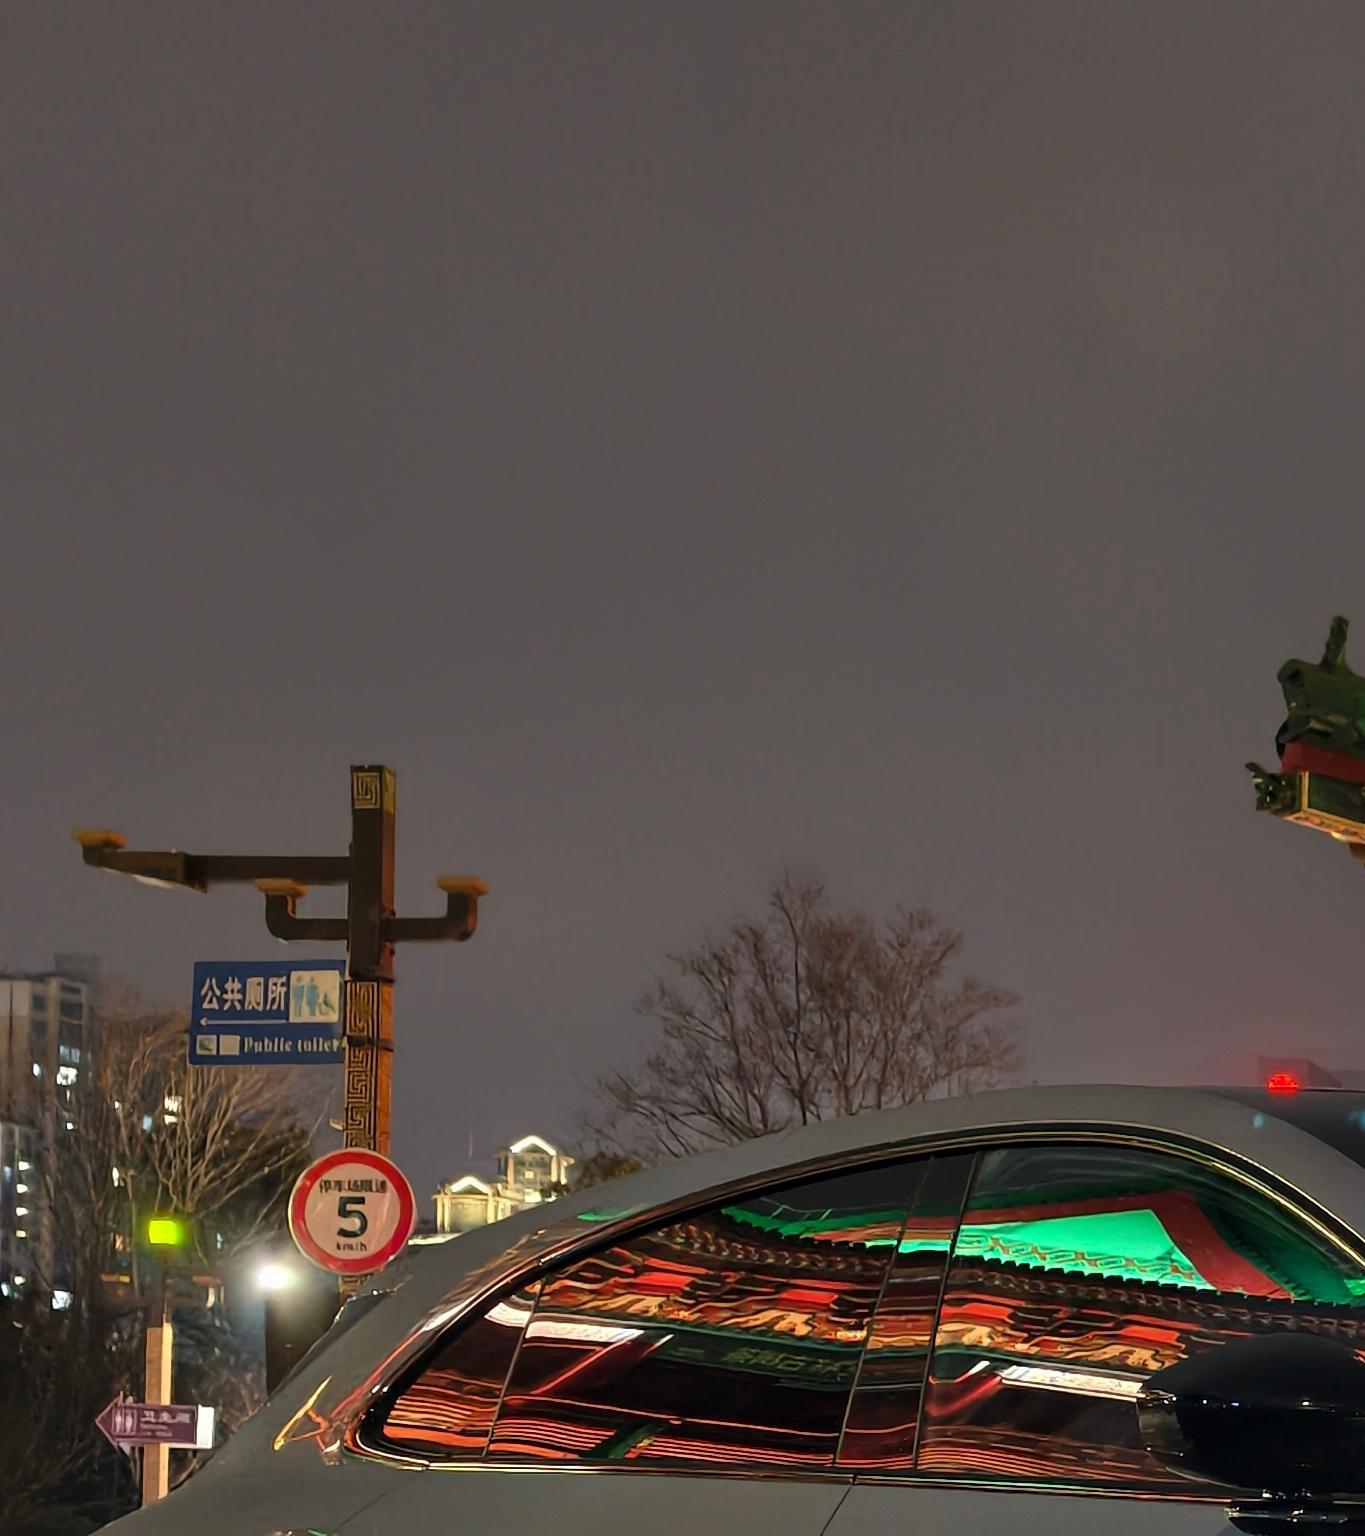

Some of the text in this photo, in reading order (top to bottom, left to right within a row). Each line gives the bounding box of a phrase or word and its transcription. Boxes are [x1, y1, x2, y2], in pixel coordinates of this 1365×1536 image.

[200, 976, 287, 1011] 公共厕所
[244, 1036, 292, 1053] Public
[337, 1196, 368, 1238] 5
[336, 1242, 367, 1252] km/h
